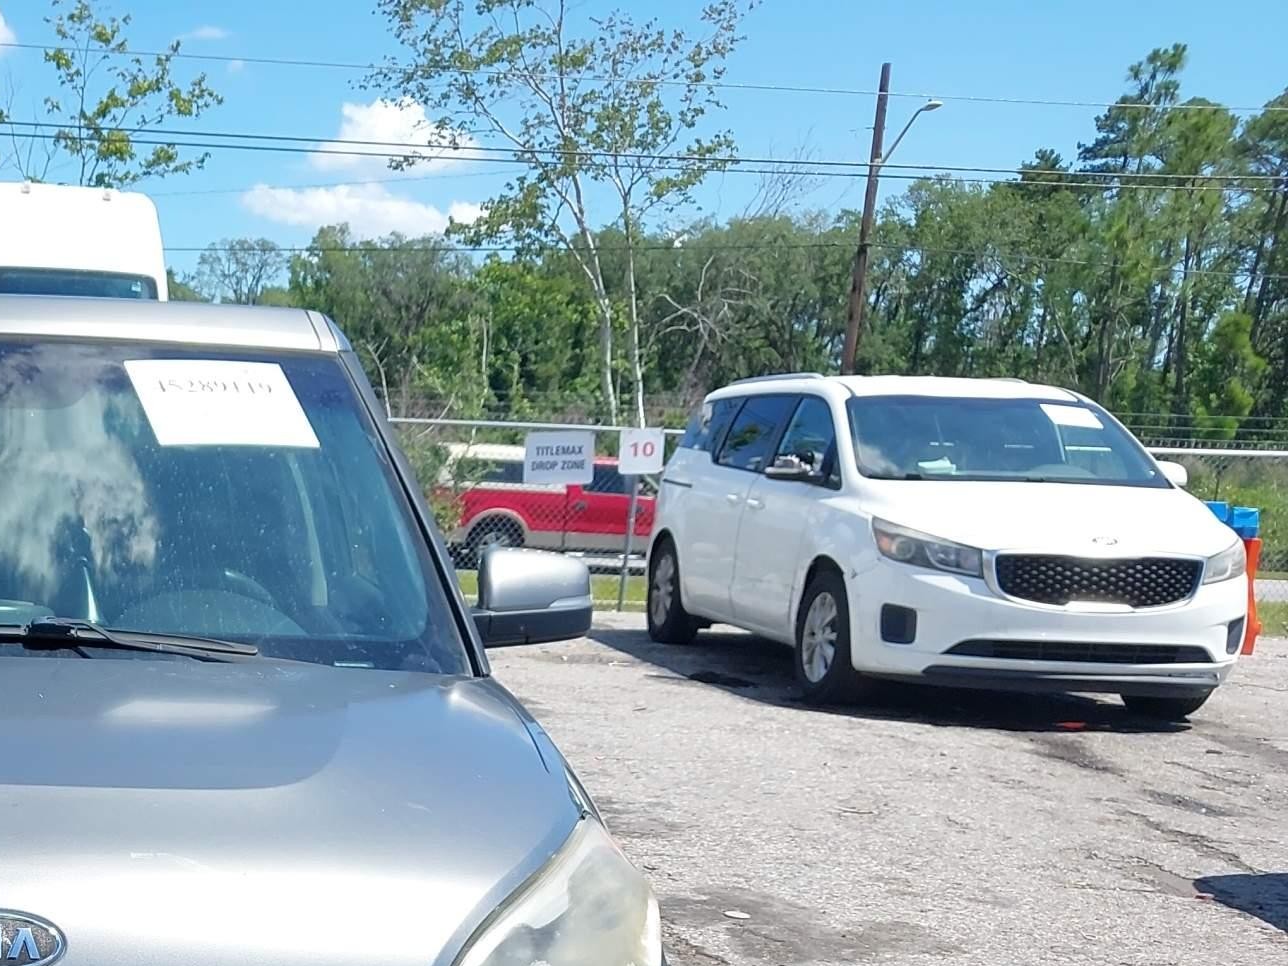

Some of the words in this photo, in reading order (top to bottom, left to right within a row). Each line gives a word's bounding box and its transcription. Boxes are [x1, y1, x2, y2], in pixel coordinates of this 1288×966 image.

[535, 444, 584, 457] TITLEMAX
[630, 441, 655, 457] 10
[531, 460, 559, 472] DROP
[560, 459, 586, 471] ZONE
